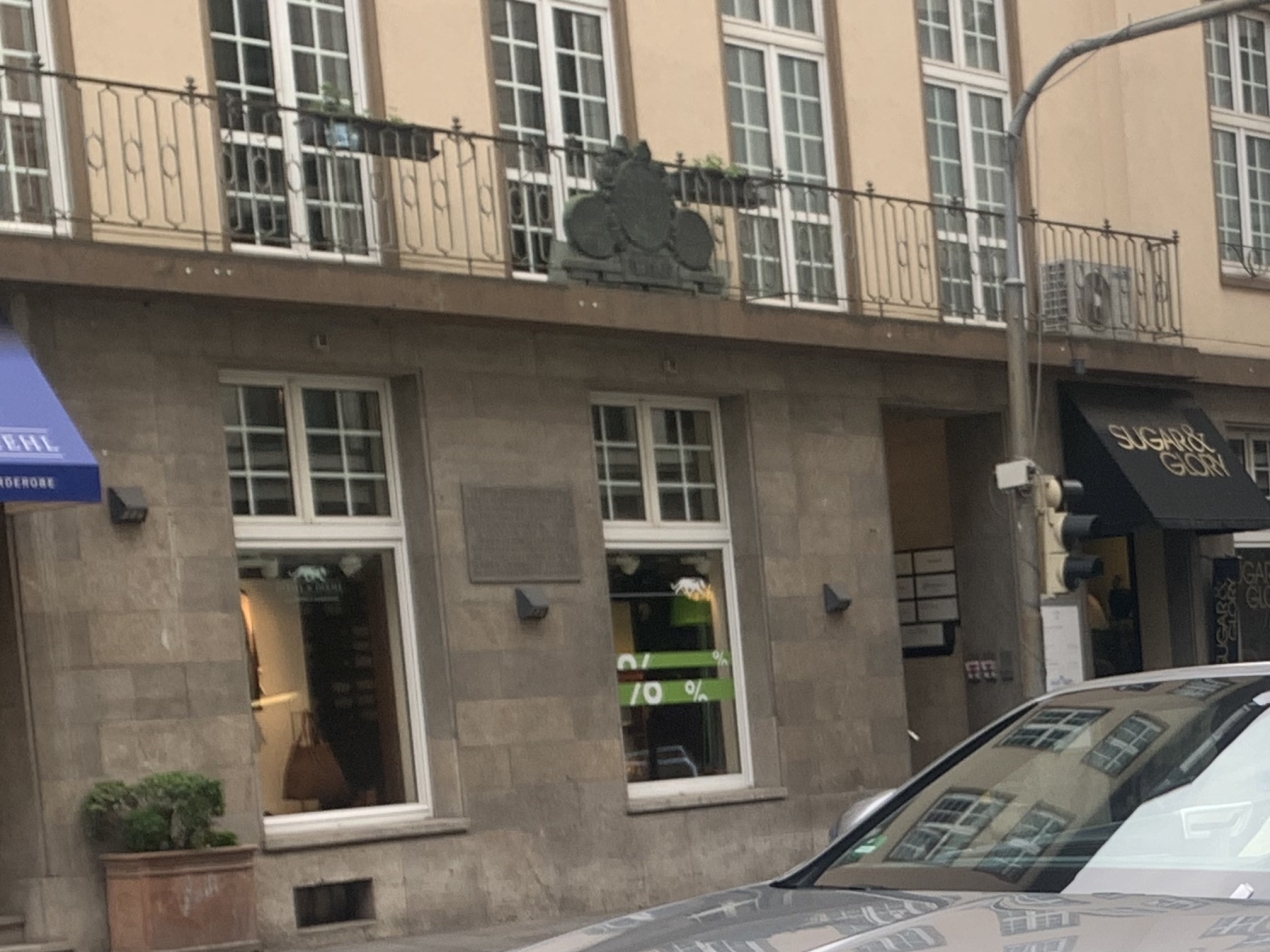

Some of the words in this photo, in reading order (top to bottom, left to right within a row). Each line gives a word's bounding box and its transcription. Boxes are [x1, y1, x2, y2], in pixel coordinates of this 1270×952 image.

[0, 433, 60, 453] EHL
[1108, 424, 1216, 453] SUGAR&
[1159, 451, 1231, 478] GLORY
